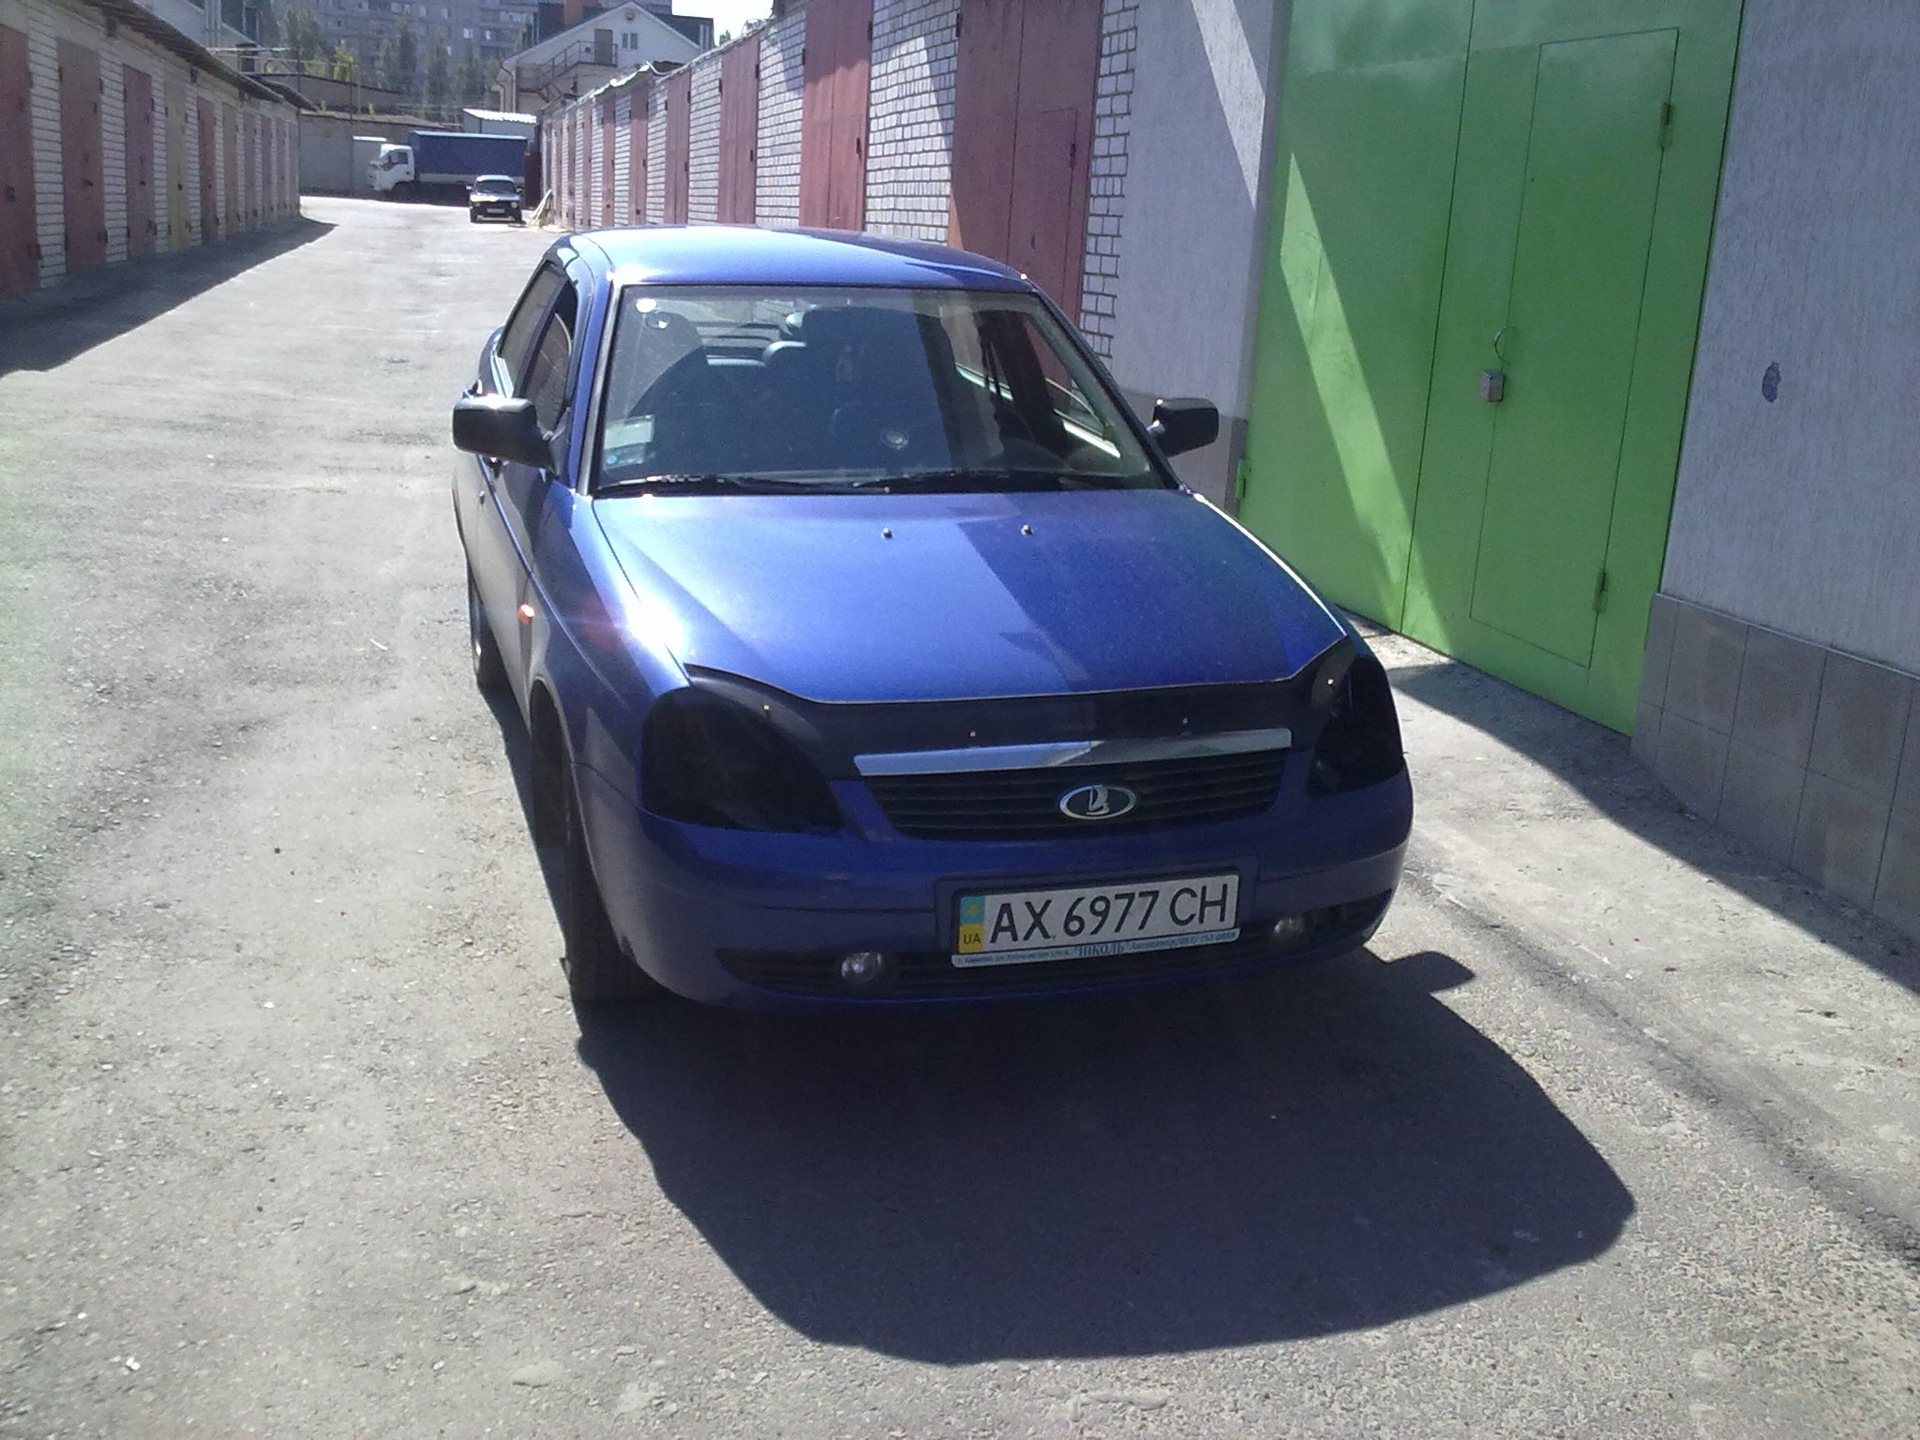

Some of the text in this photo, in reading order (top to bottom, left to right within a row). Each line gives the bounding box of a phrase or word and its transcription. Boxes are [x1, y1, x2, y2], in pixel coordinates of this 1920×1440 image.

[990, 883, 1229, 944] AX 6977 CH
[963, 934, 981, 945] UA
